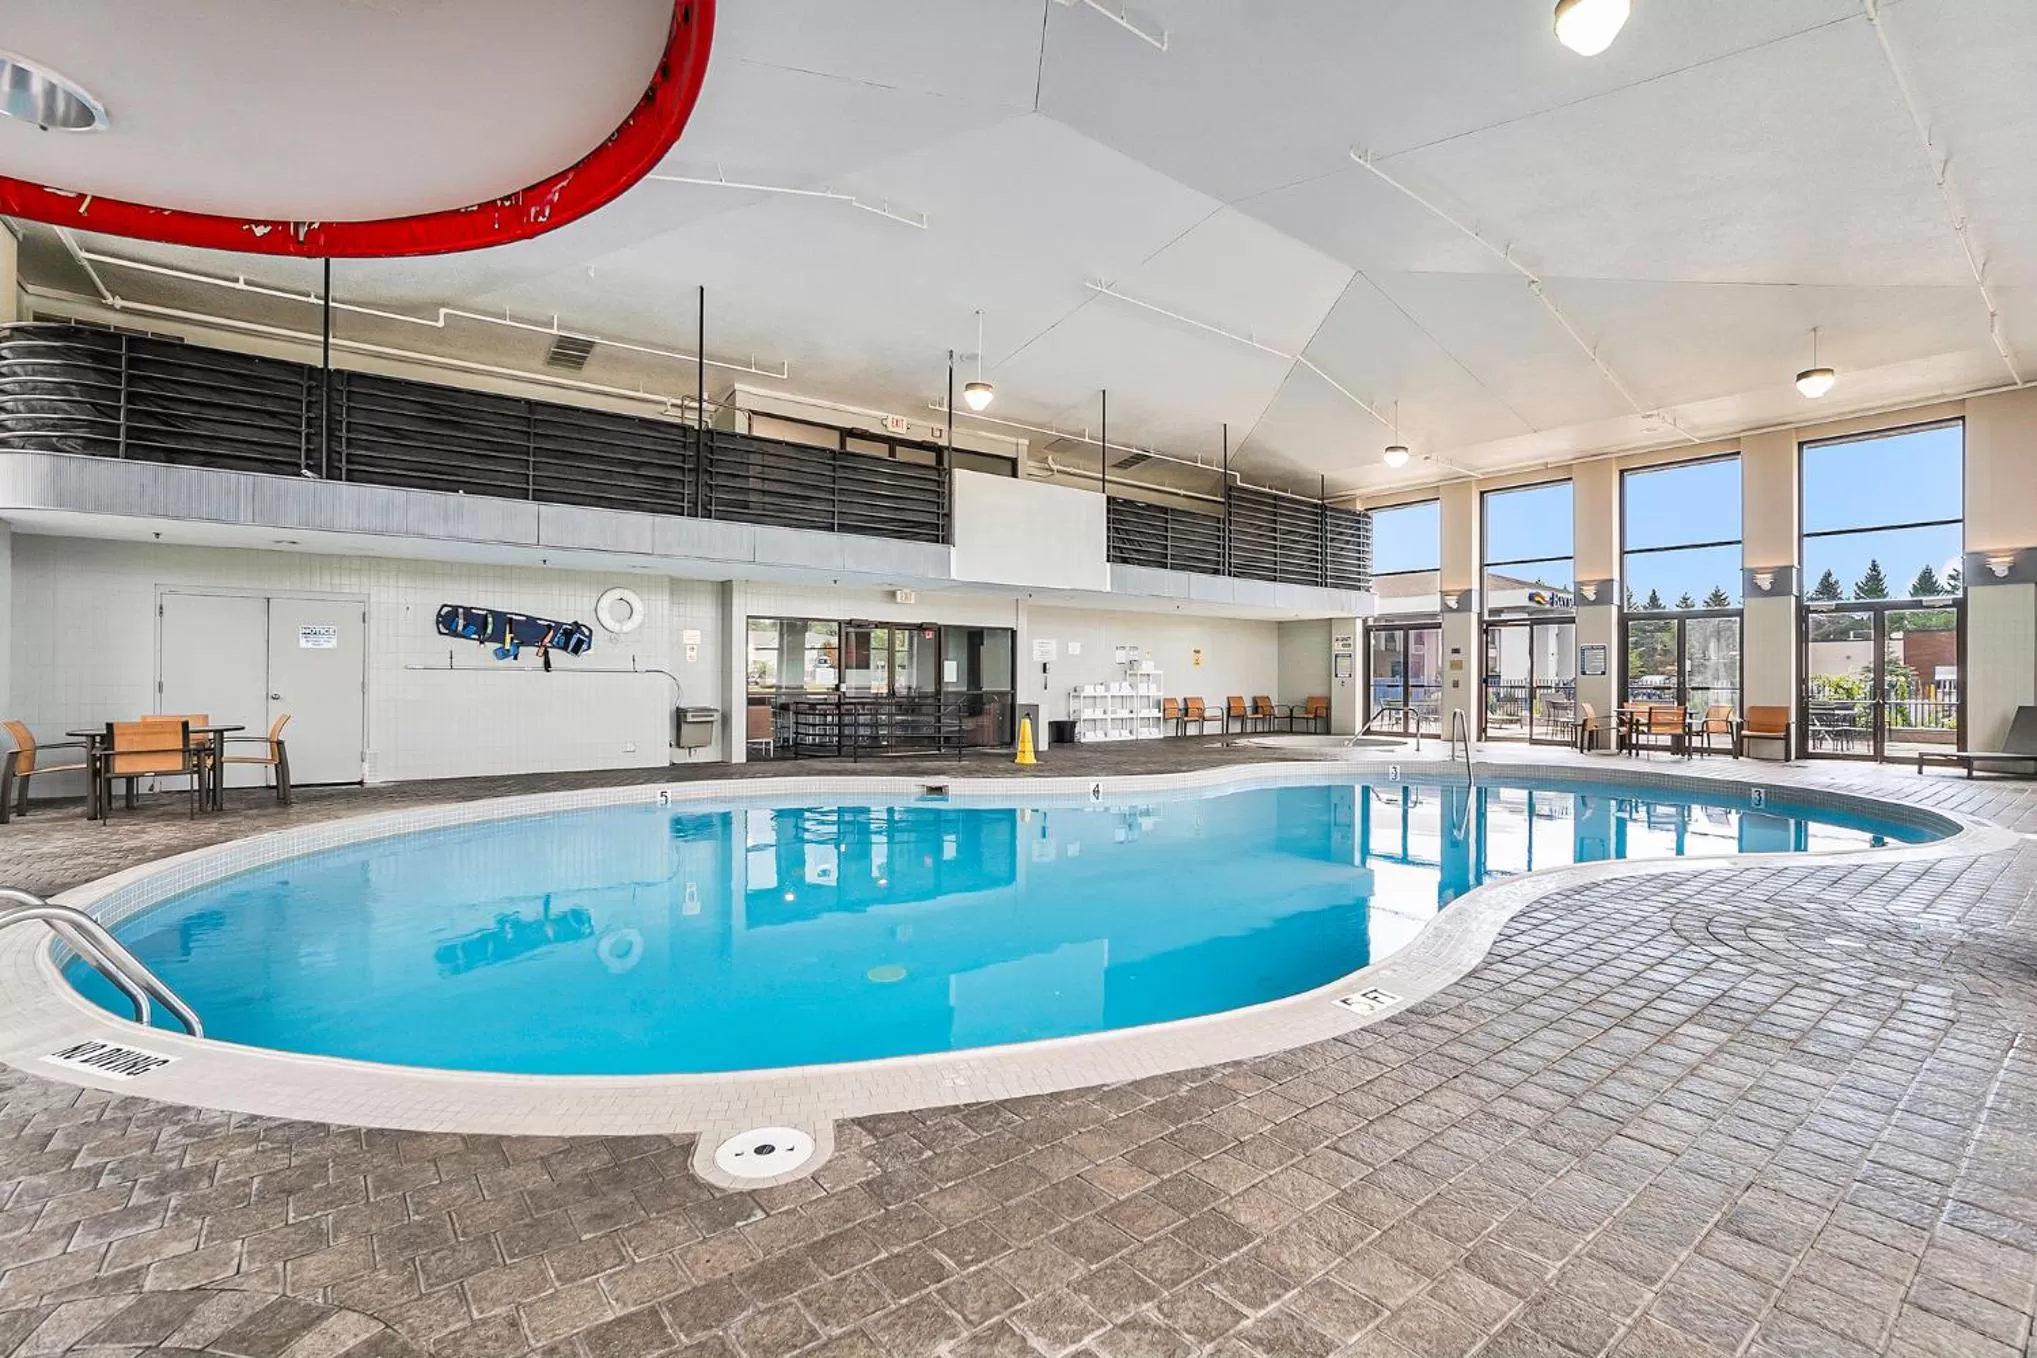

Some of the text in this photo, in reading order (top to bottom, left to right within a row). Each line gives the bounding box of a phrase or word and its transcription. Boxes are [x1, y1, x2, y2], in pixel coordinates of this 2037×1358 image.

[891, 416, 905, 430] EXIT
[660, 791, 668, 806] 5
[1092, 783, 1100, 801] 4
[1754, 789, 1762, 807] 3
[1361, 988, 1397, 1004] FT
[51, 1041, 170, 1076] NO DIVING
